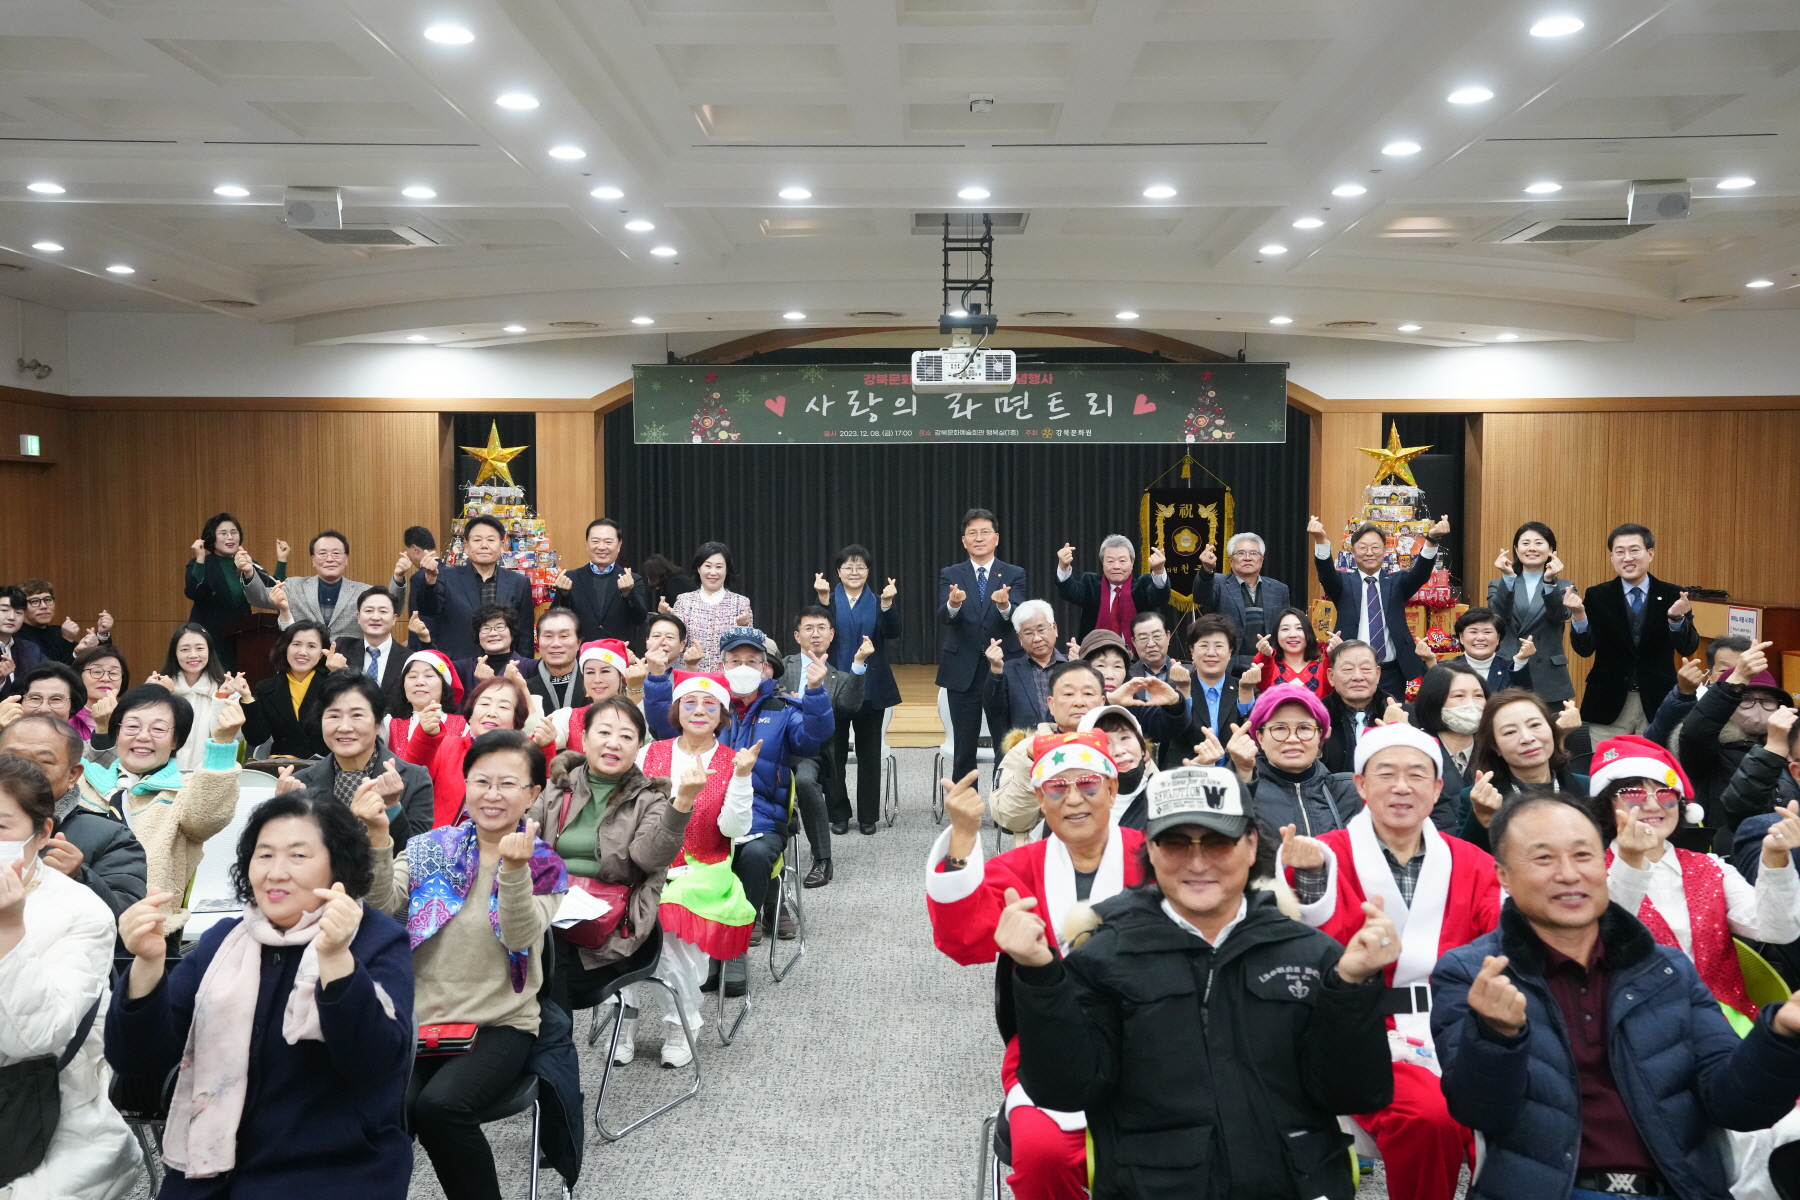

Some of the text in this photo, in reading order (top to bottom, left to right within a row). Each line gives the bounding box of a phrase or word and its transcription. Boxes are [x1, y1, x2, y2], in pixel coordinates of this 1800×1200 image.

[805, 390, 917, 422] 사랑의
[881, 429, 894, 437] (금)
[1055, 429, 1092, 437] 강북문화원
[1179, 503, 1194, 518] 祝
